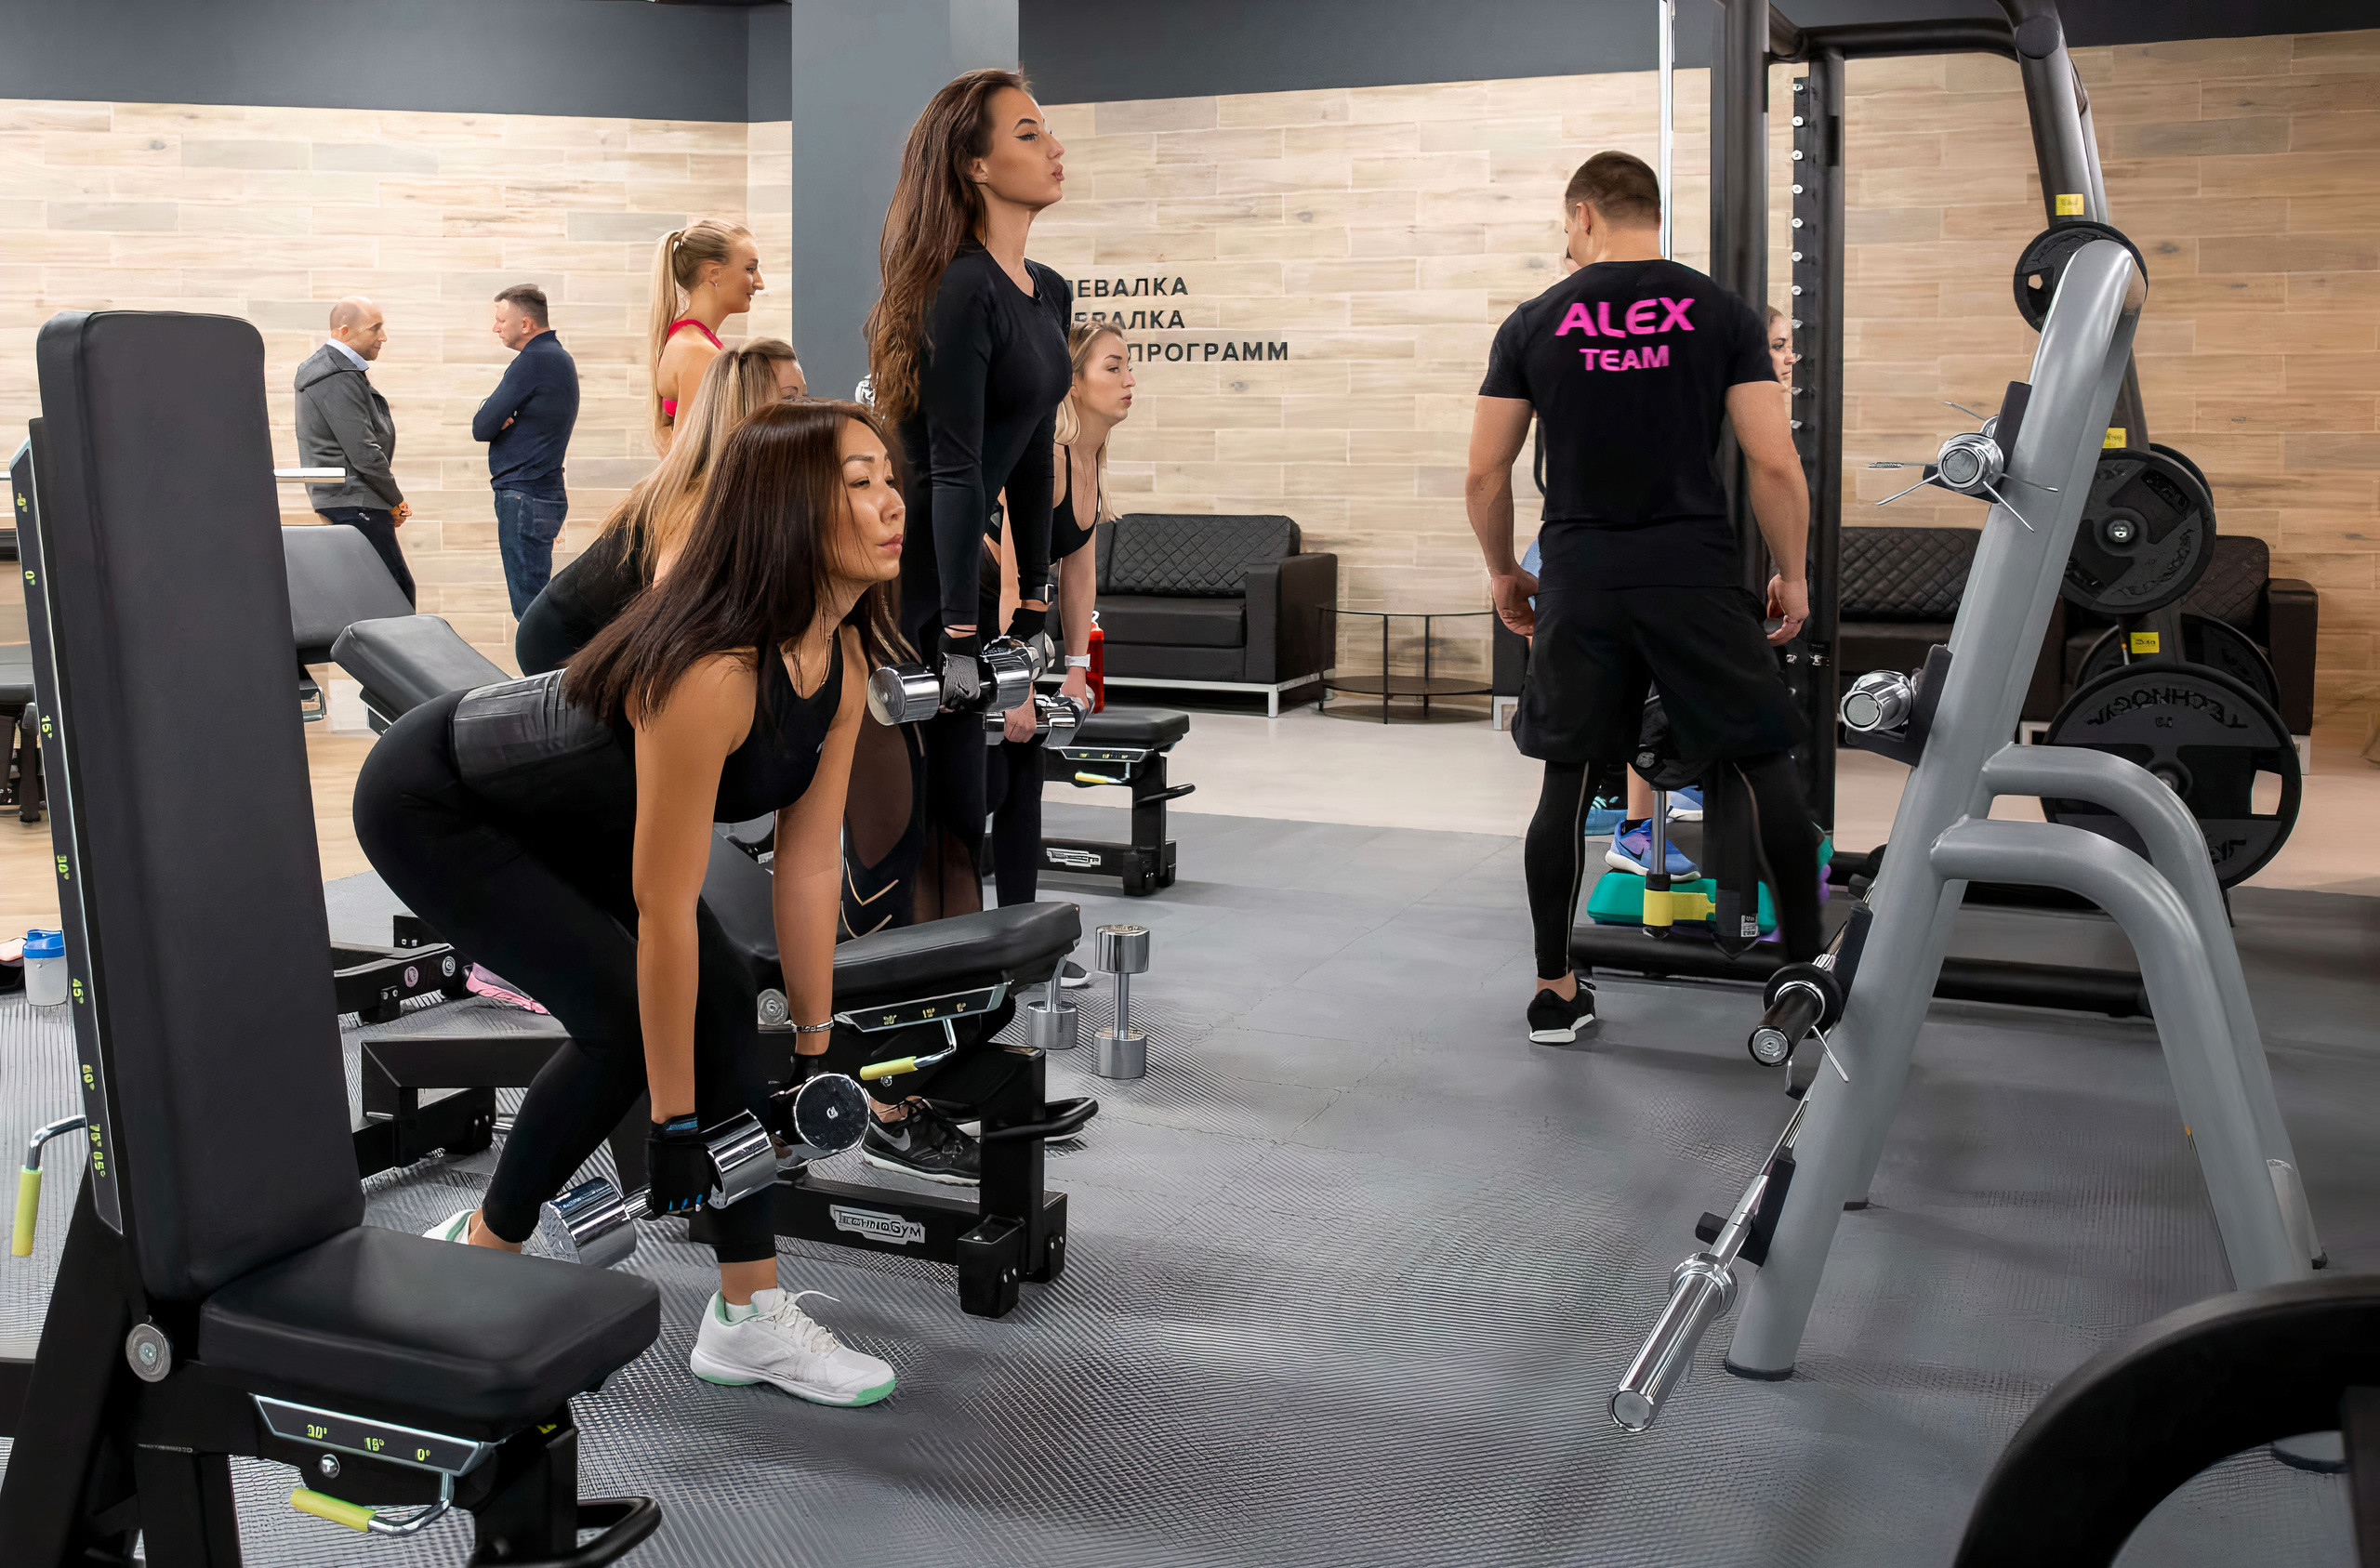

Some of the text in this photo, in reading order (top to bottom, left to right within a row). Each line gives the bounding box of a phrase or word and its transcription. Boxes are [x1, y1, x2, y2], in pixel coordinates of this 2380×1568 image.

[1074, 310, 1185, 330] ЕВАЛКА
[1554, 296, 1696, 338] ALEX
[1127, 341, 1289, 362] ПРОГРАММ
[1579, 345, 1670, 372] TEAM
